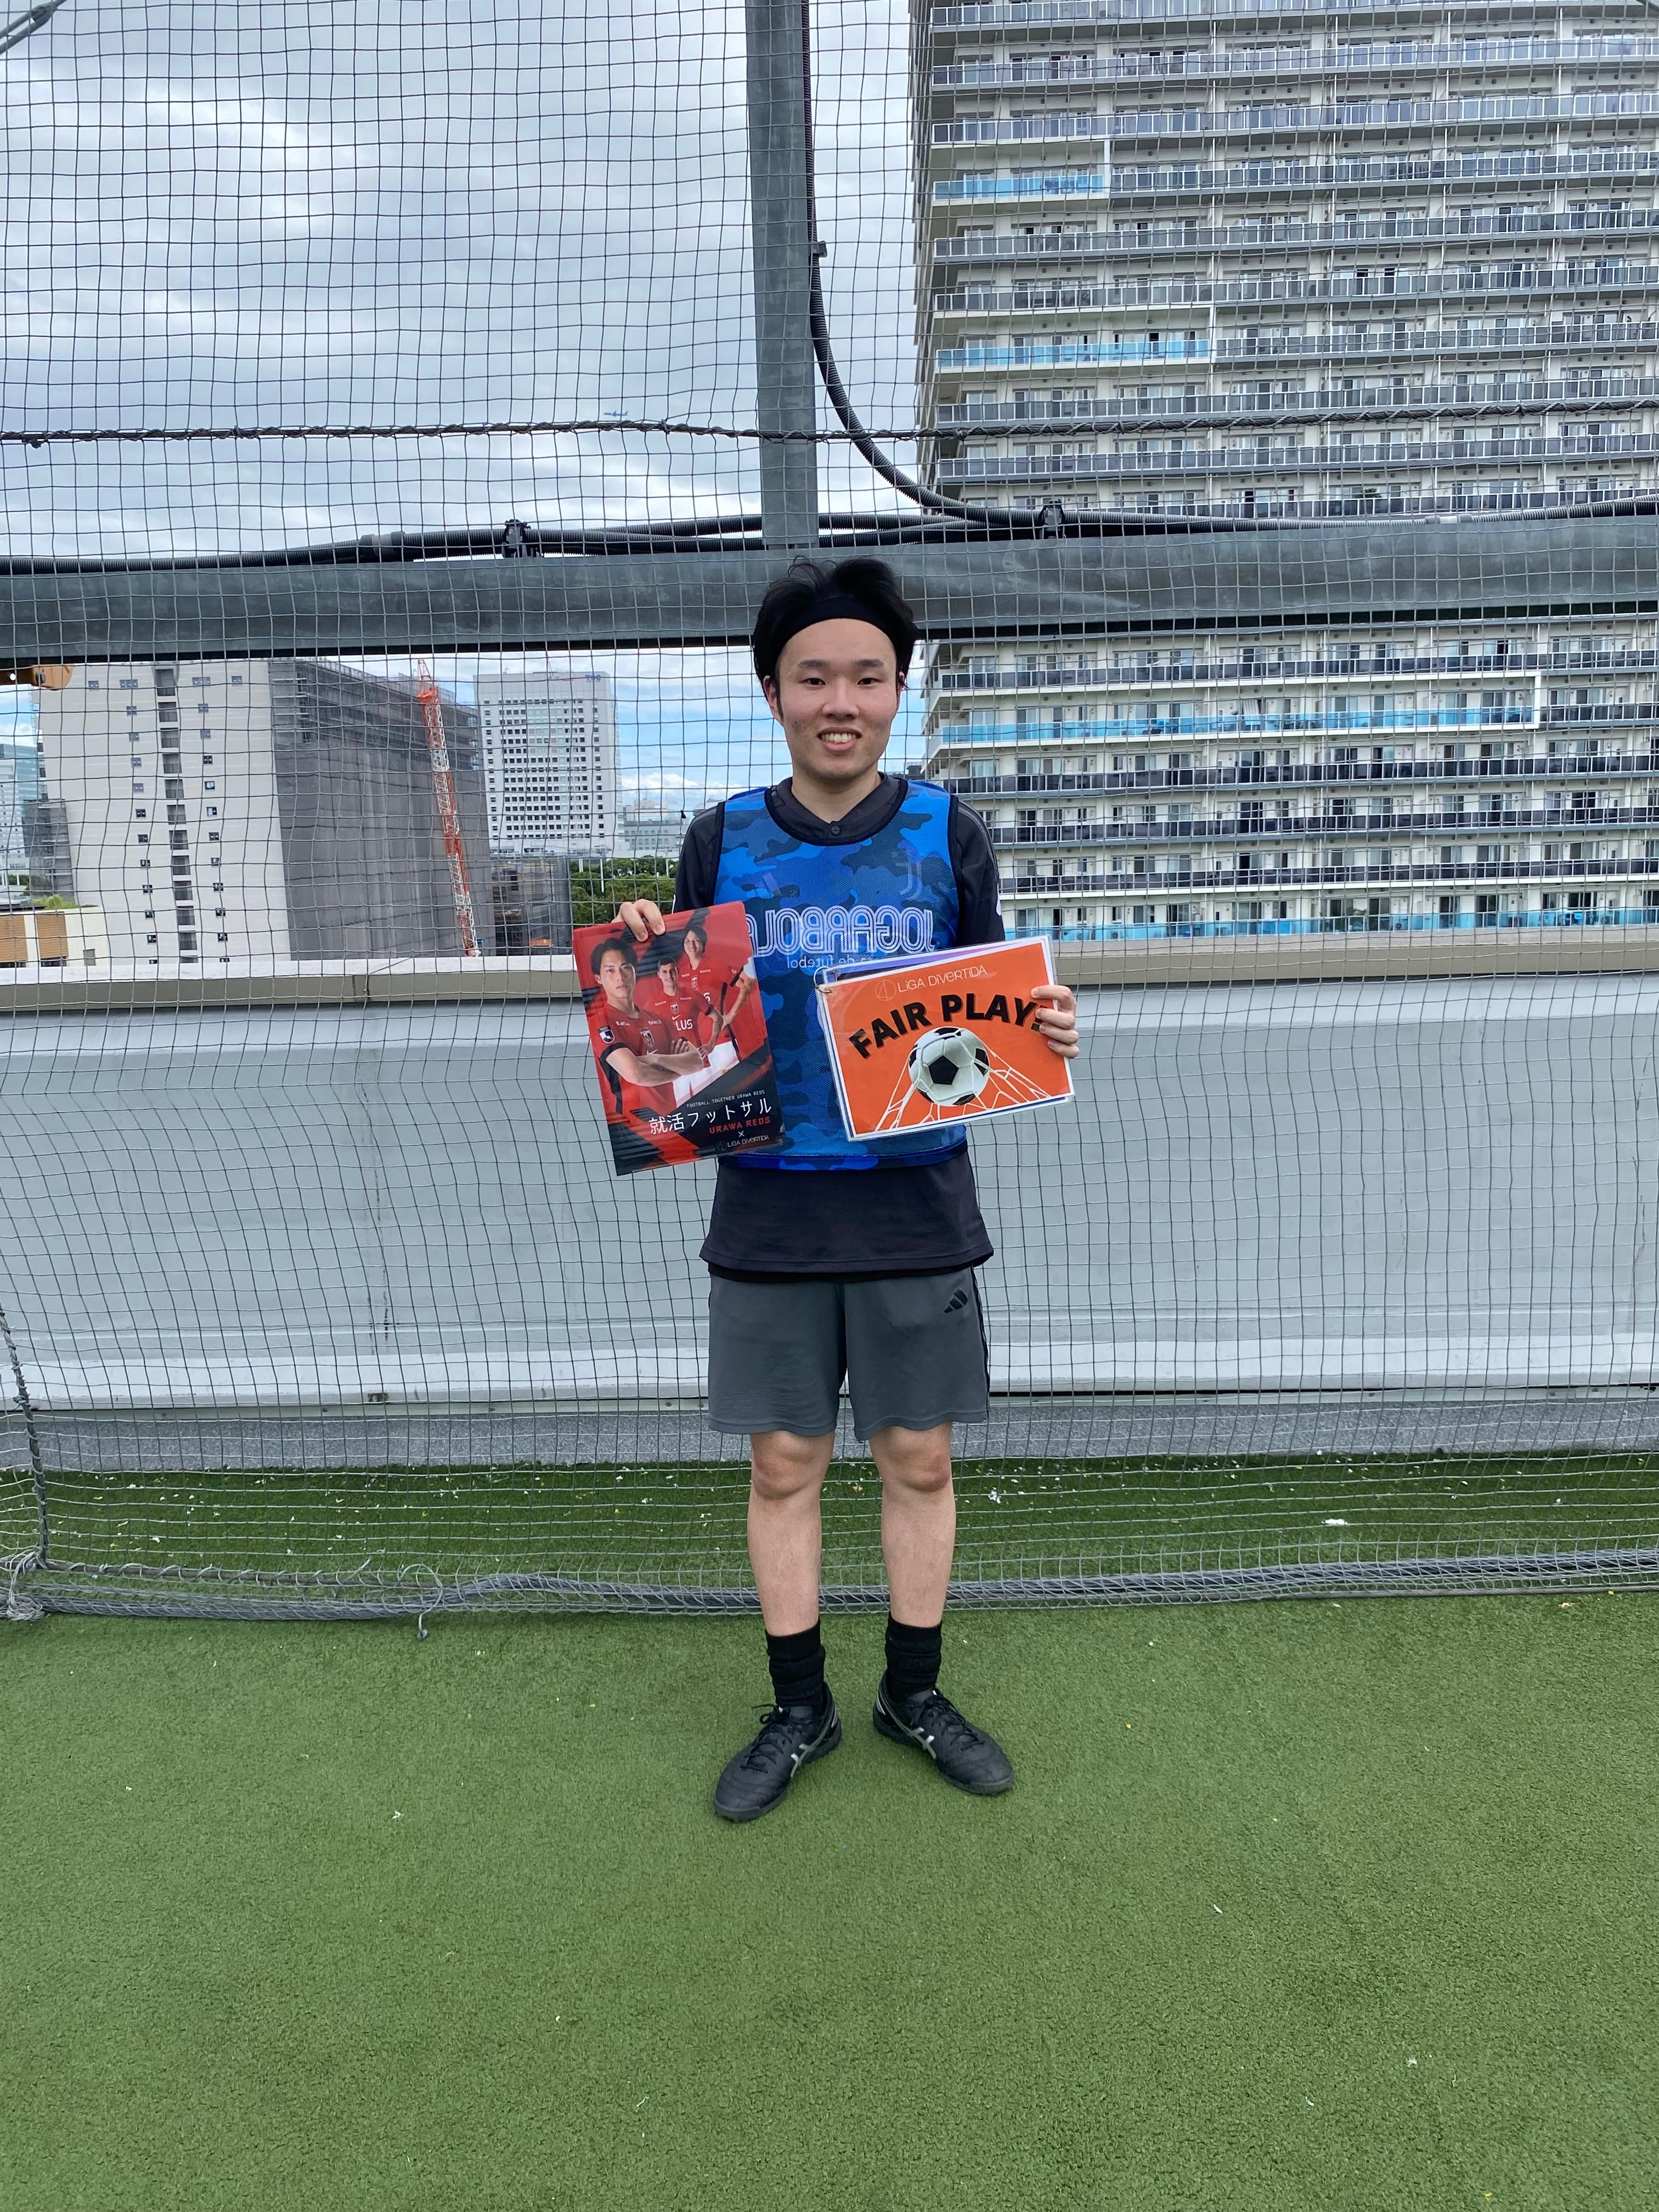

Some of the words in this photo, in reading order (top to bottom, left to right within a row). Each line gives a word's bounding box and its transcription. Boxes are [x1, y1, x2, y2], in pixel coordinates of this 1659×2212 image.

[674, 1019, 693, 1031] LUS
[848, 1001, 933, 1059] FAIR
[712, 1096, 735, 1104] TOGETHER
[648, 1097, 772, 1135] 就活フットサル
[709, 1122, 743, 1134] URAWA
[746, 1116, 771, 1127] REDS
